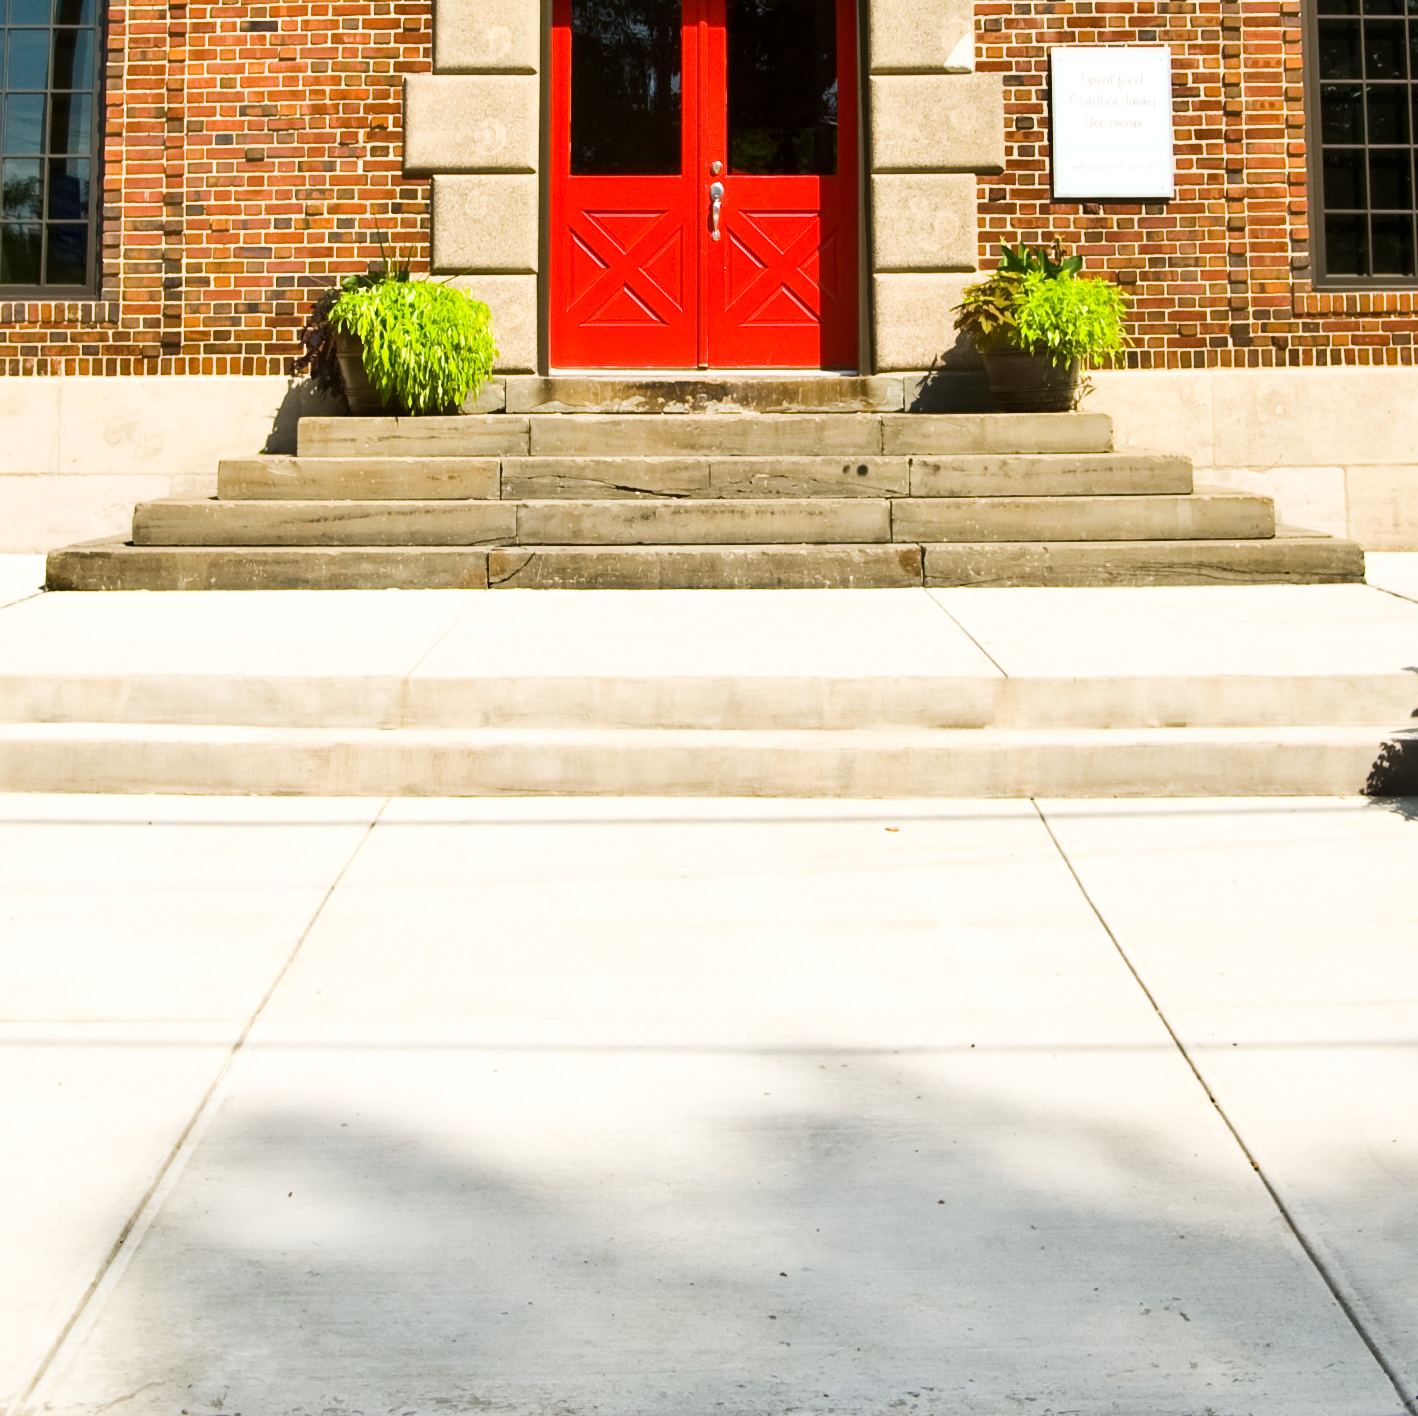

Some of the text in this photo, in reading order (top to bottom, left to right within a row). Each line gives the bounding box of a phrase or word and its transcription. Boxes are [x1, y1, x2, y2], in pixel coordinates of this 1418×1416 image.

[1080, 71, 1144, 90] Great food
[1069, 91, 1157, 112] Outdoor dining
[1108, 119, 1144, 129] cream
